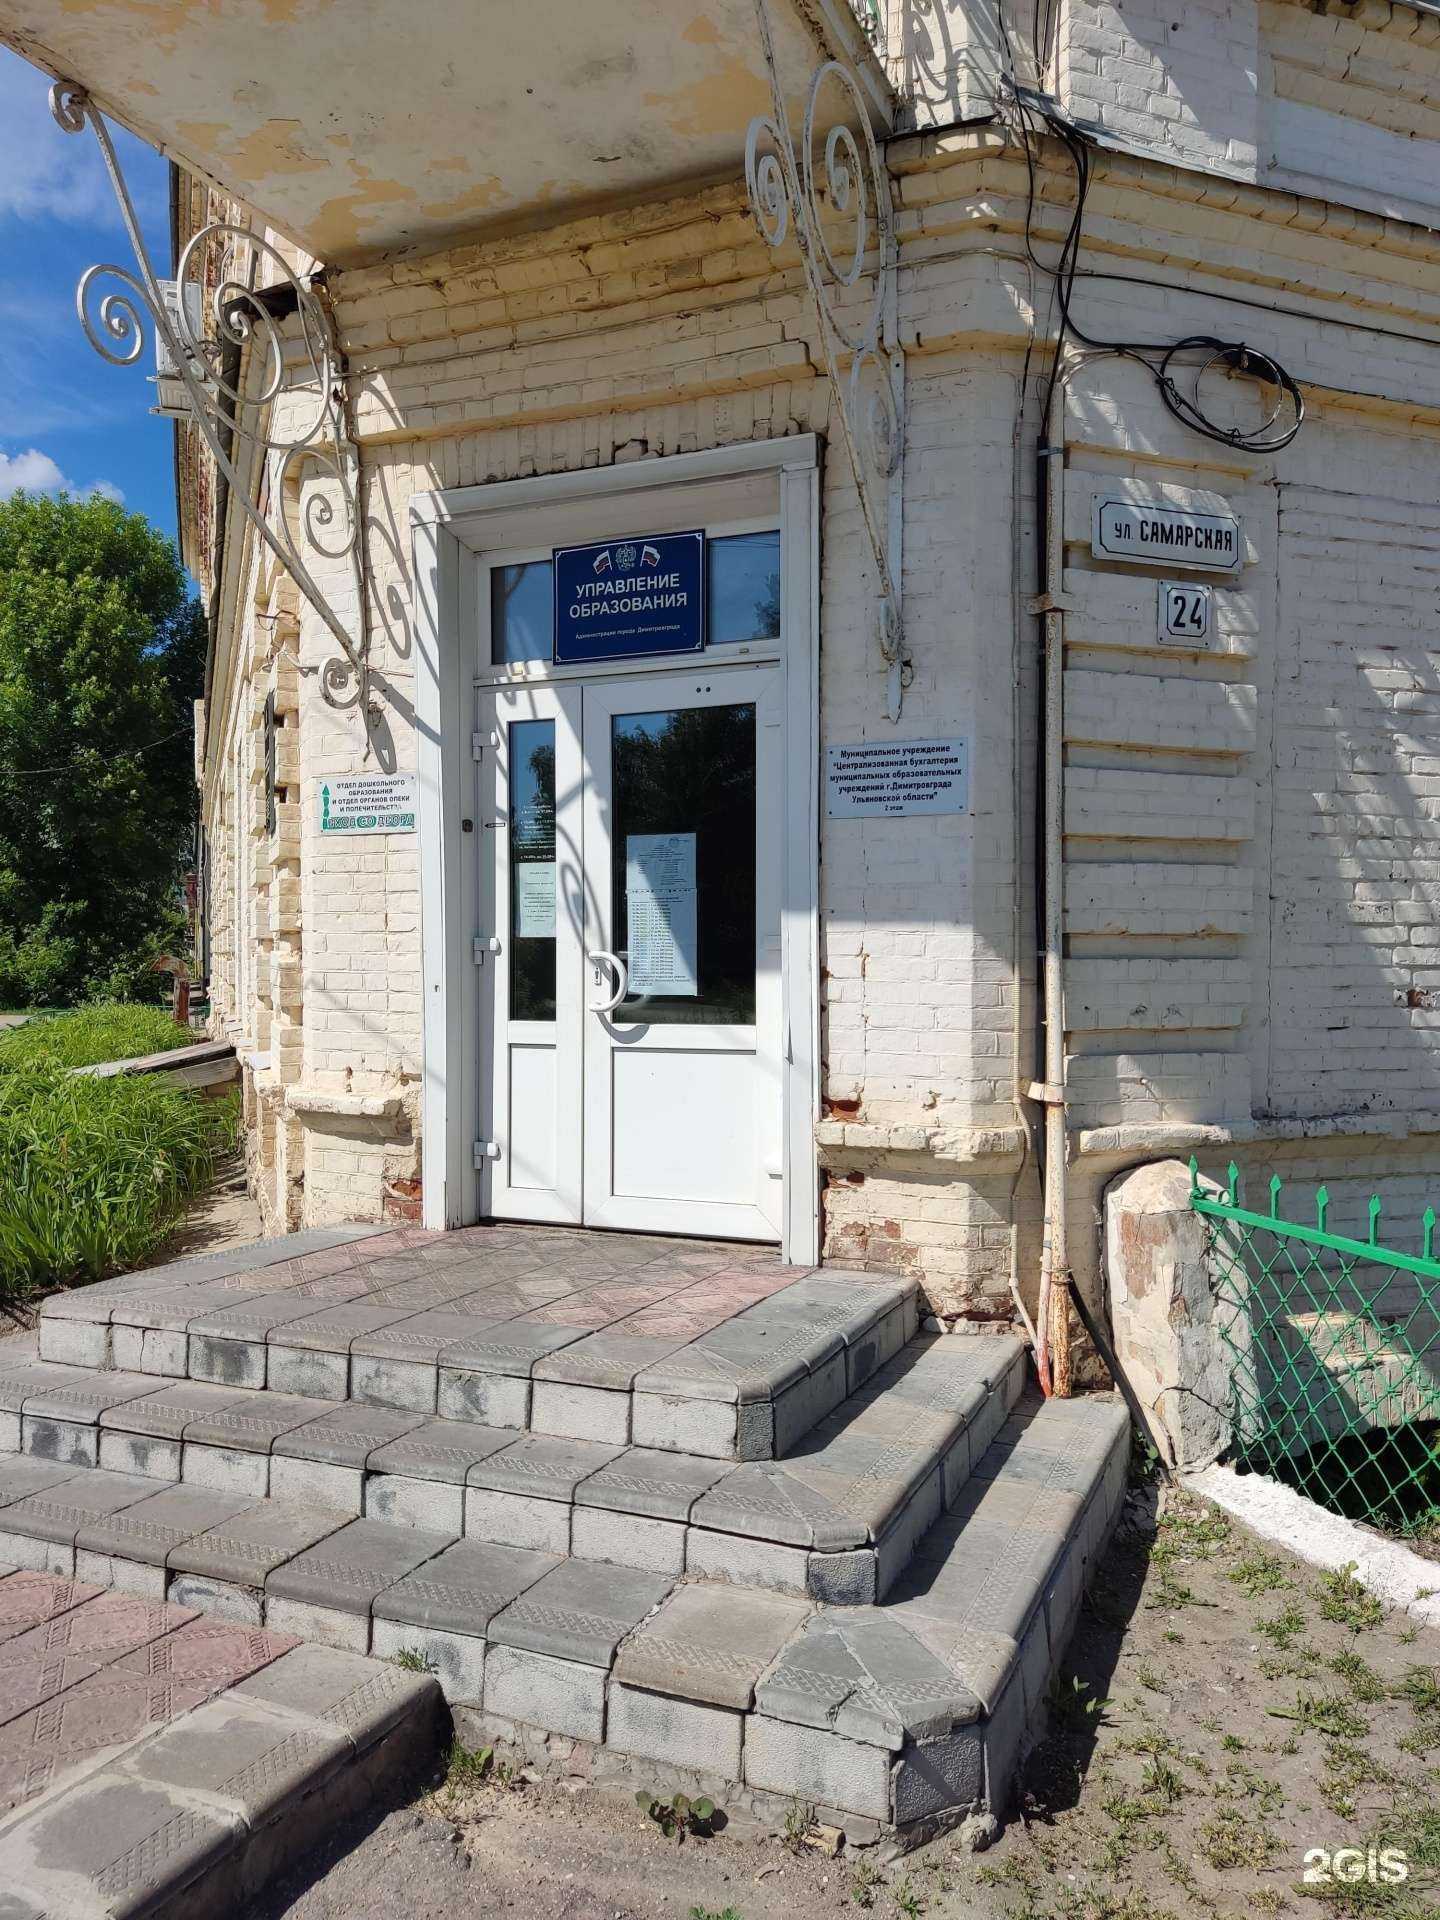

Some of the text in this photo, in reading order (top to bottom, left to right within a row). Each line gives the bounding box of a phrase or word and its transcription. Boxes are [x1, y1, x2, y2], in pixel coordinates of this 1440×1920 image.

[1114, 520, 1232, 551] ул. САМАРСКАЯ
[576, 573, 680, 599] УПРАВЛЕНИЕ
[569, 592, 688, 619] ОБРАЗОВАНИЯ
[1173, 595, 1202, 629] 24
[840, 744, 951, 760] Муниципальное учреждение
[909, 756, 959, 768] бухгалтерия
[358, 779, 405, 788] ДОШКОЛЬНОГО
[830, 768, 962, 784] муниципальных образовательных
[348, 788, 393, 796] ОБРАЗОВАНИЯ
[838, 780, 952, 795] учреждений г.Димитровграда
[852, 794, 901, 804] Ульяновской
